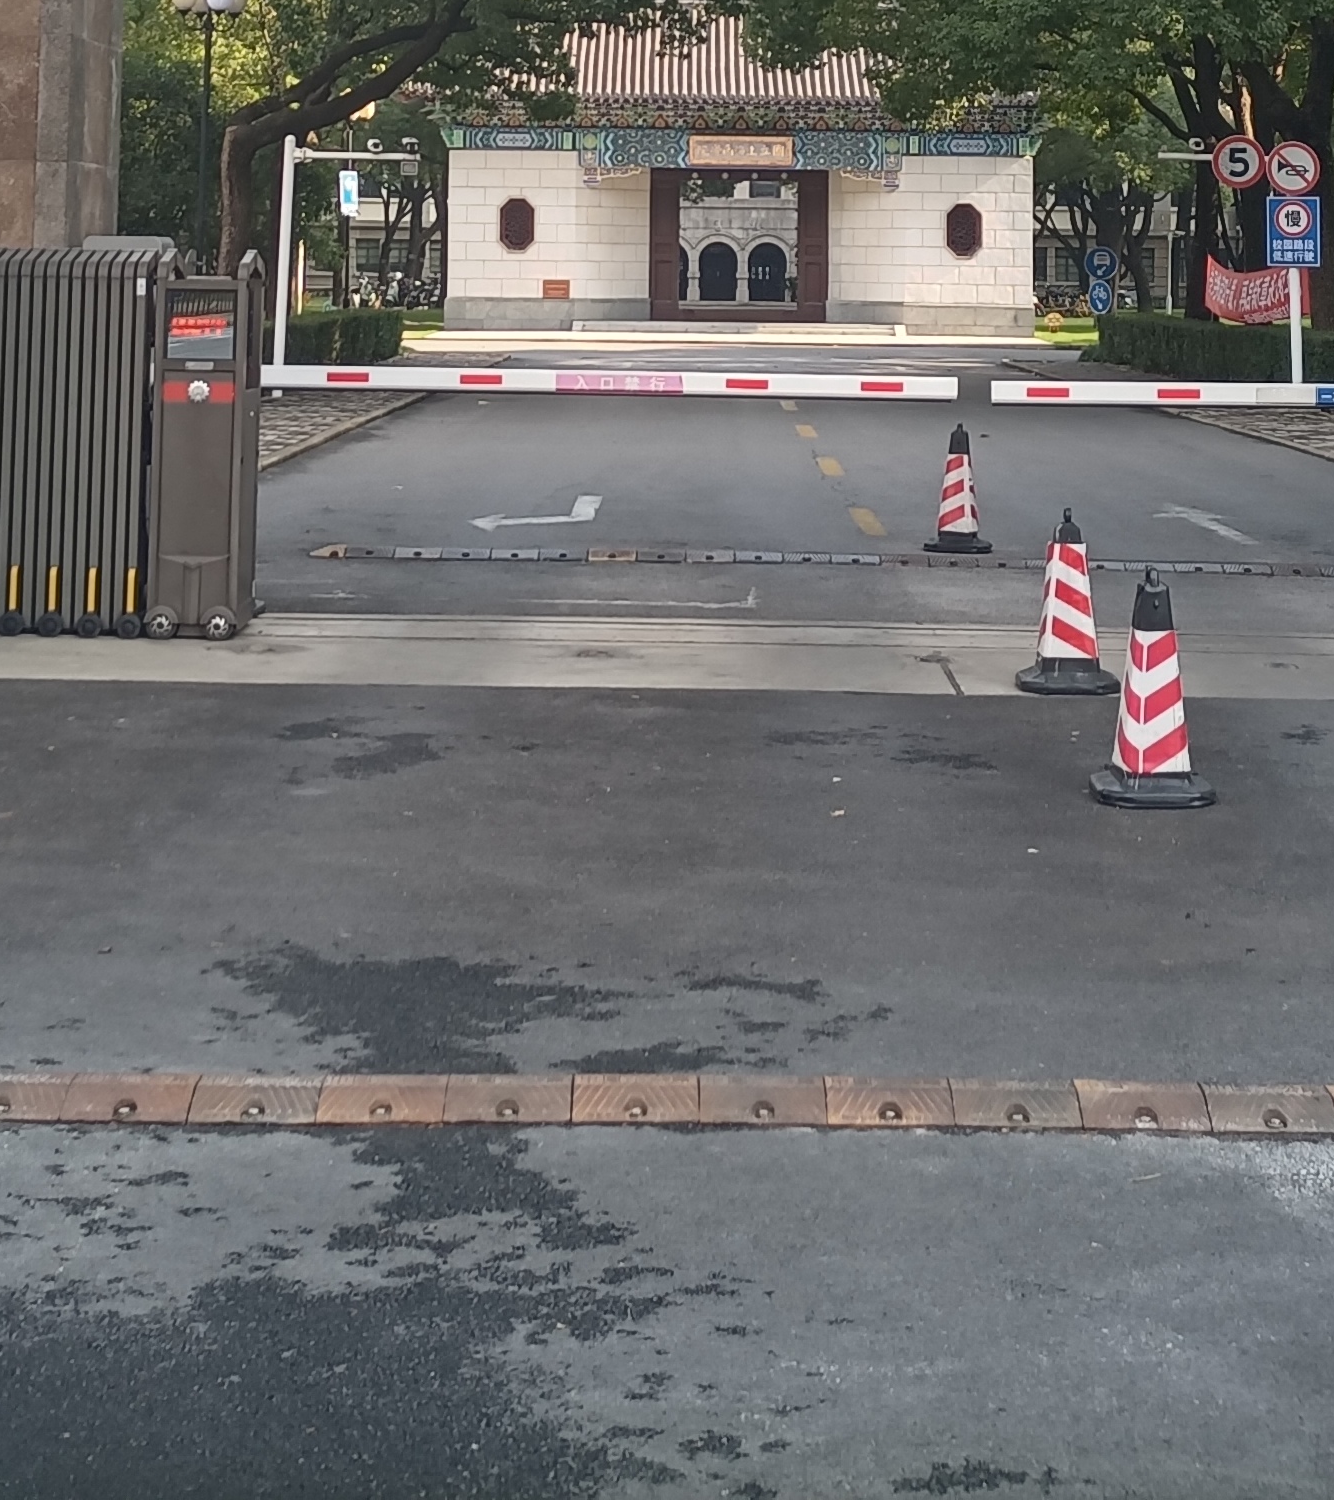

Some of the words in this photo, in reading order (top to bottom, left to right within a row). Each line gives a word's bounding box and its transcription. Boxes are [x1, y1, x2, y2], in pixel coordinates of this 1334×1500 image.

[1228, 147, 1250, 177] 5
[1284, 209, 1302, 227] 慢
[573, 375, 666, 391] 入口禁行
